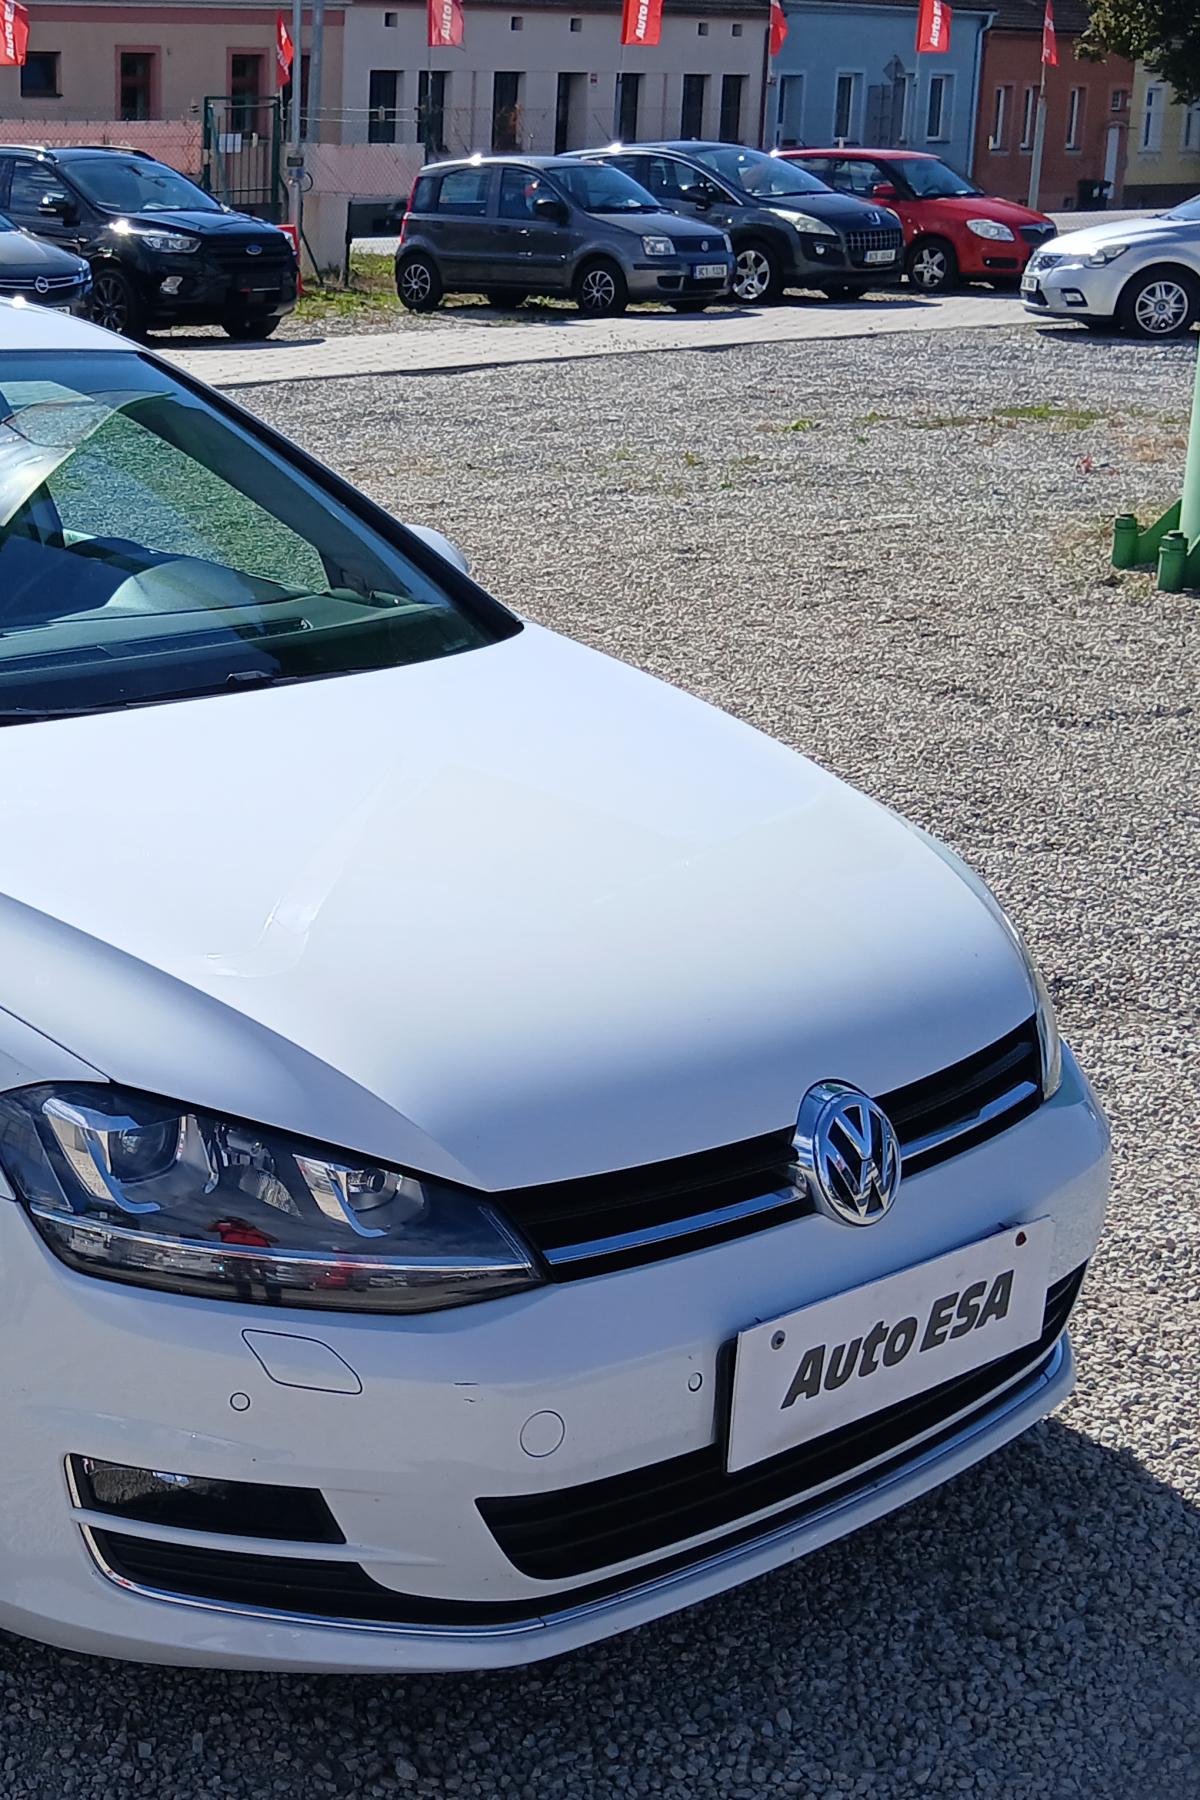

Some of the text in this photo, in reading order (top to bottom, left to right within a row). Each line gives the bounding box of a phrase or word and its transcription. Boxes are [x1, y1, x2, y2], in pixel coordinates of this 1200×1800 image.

[441, 4, 452, 40] Auto
[635, 5, 649, 40] Auto
[930, 15, 942, 47] Auto
[4, 21, 15, 60] Auto
[780, 1269, 1014, 1409] Auto ESA
